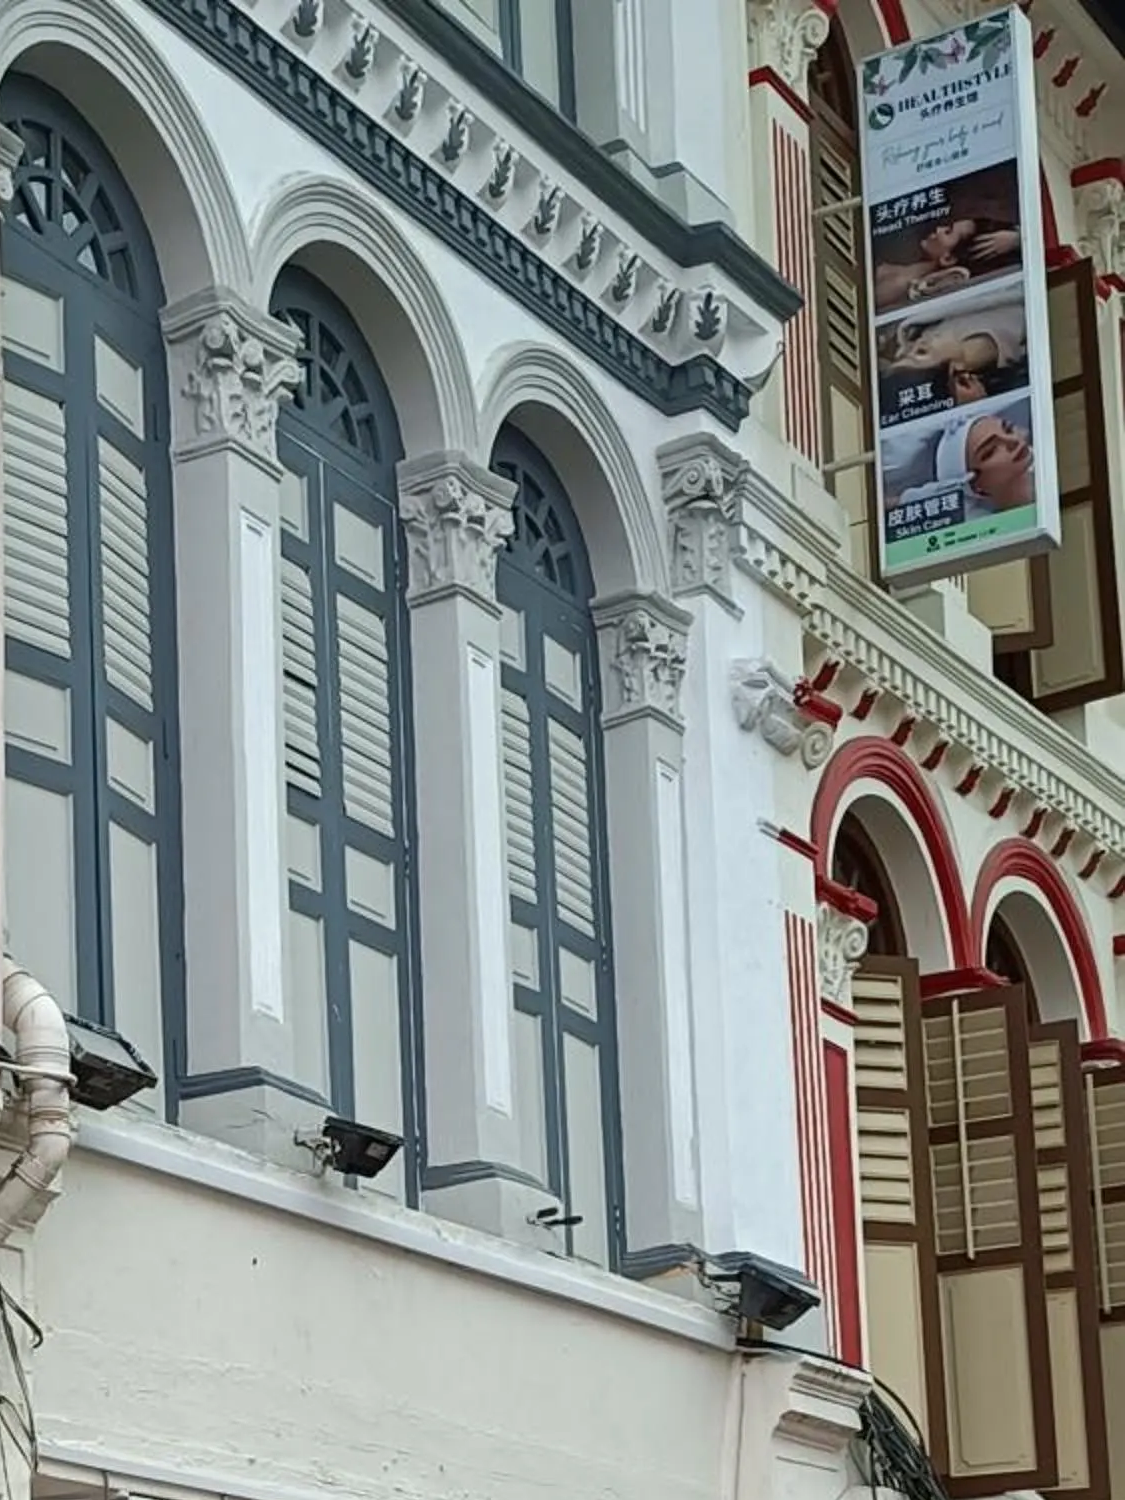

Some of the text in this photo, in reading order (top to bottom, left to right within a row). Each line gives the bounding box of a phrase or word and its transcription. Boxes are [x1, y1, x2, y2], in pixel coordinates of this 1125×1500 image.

[874, 186, 947, 224] 头疗养生
[873, 206, 952, 236] Head Therapy
[898, 382, 933, 407] 采耳
[880, 397, 955, 426] Ear Cleaning
[888, 493, 960, 527] 皮肤管理
[896, 516, 952, 539] Skin Care
